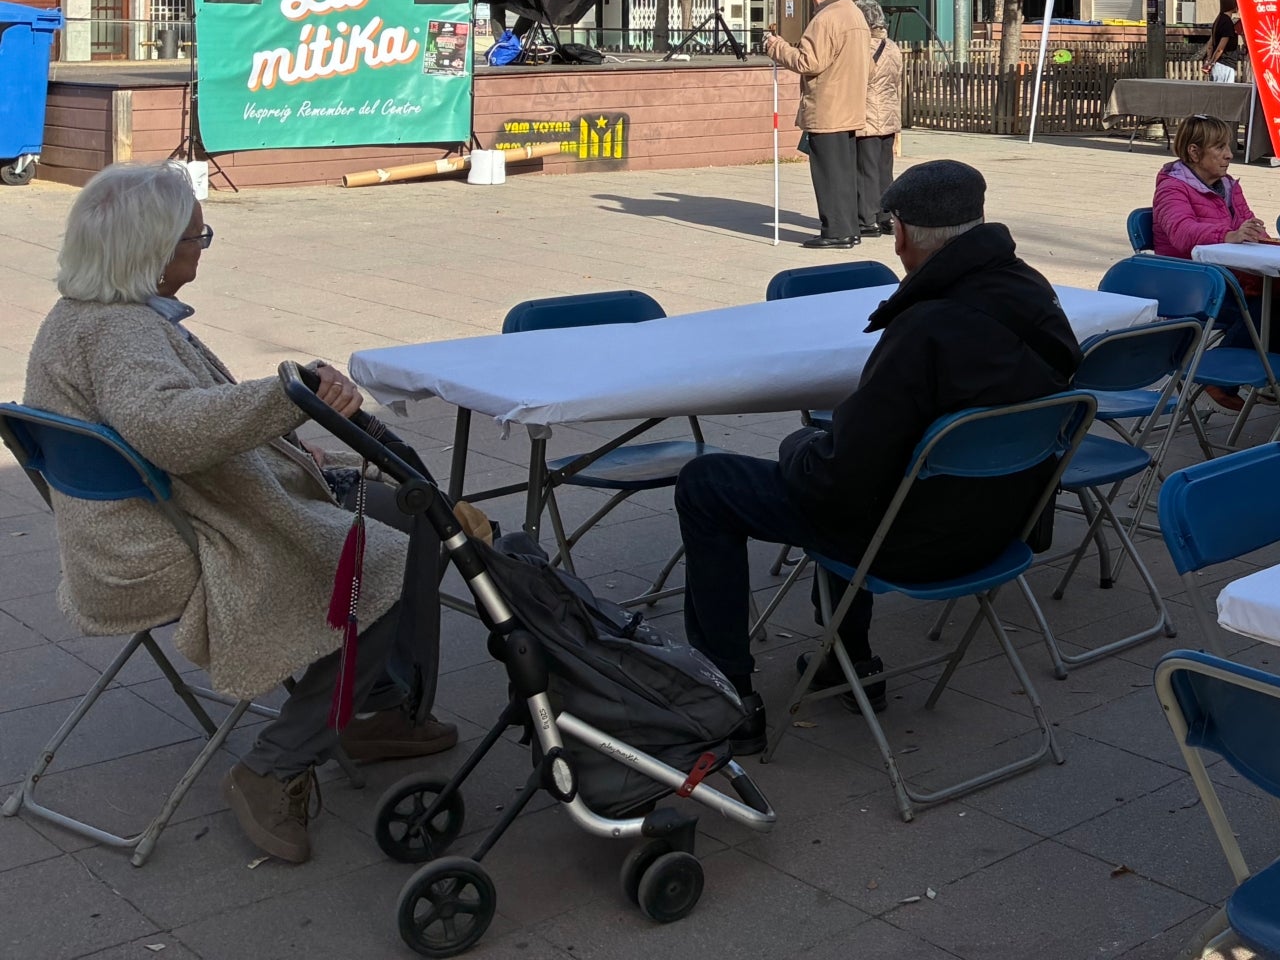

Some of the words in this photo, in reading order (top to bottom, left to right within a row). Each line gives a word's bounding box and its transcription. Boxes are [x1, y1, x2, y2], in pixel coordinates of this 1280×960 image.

[243, 102, 292, 124] Vespreig
[297, 100, 356, 117] Remember
[358, 99, 381, 115] del
[381, 99, 422, 116] Centre
